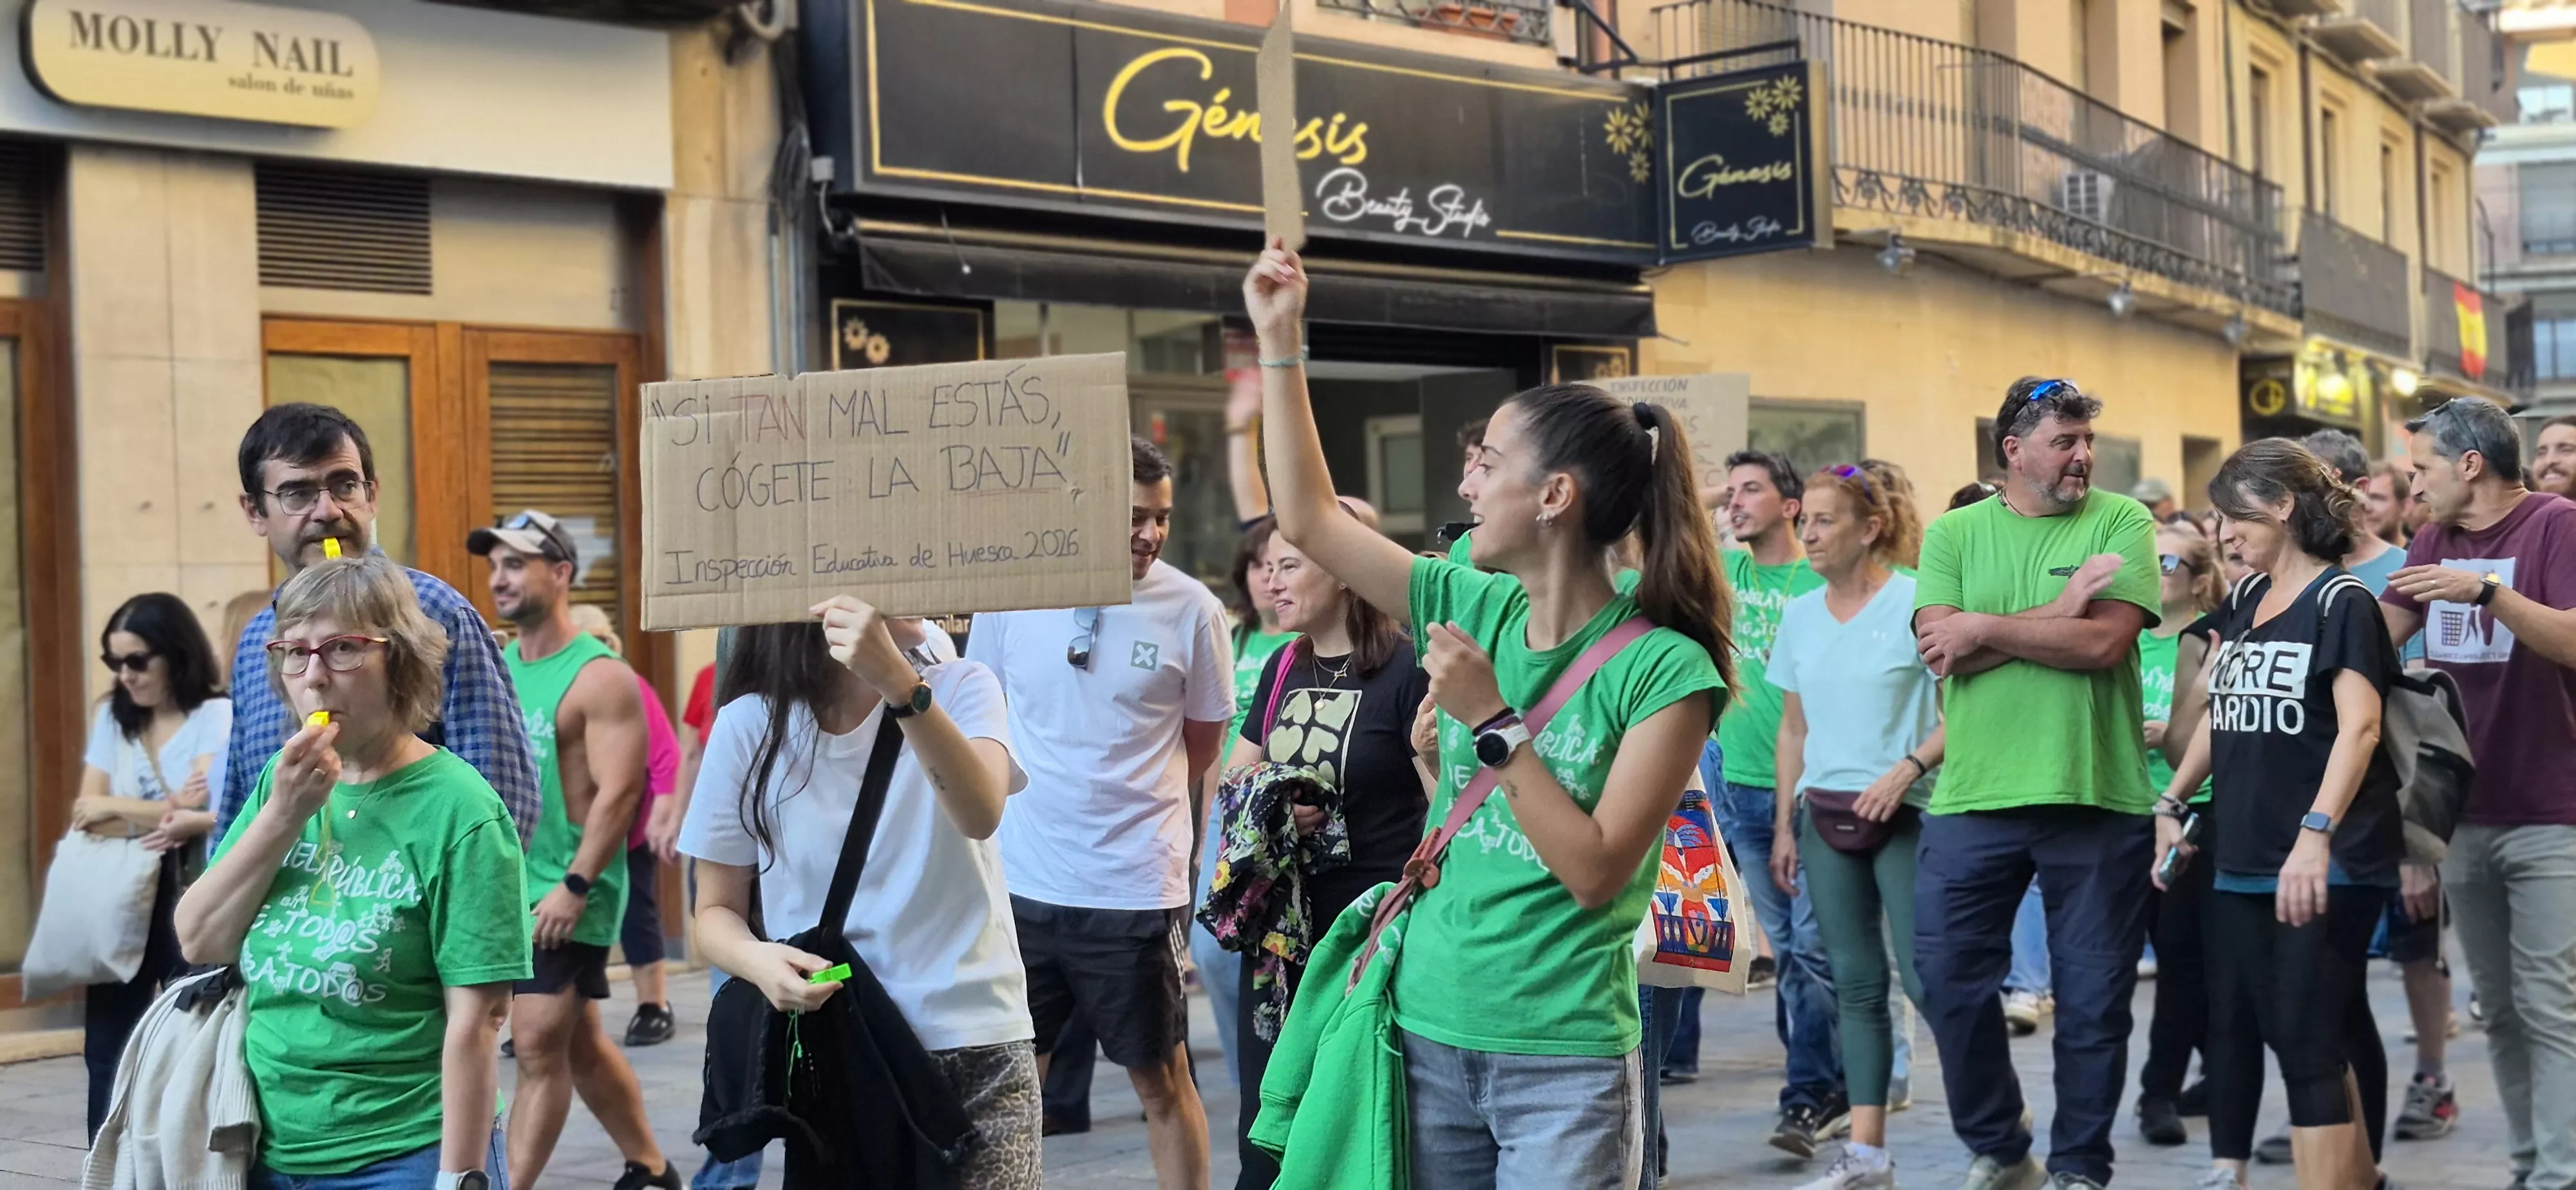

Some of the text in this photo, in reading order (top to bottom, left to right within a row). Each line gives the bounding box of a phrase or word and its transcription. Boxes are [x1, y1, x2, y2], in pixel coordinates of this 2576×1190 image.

[69, 10, 354, 77] MOLLY NAIL
[228, 74, 355, 99] salon de uñas
[1103, 47, 1368, 173] Génsis
[1316, 167, 1491, 238] Beauty Studio
[1678, 154, 1792, 199] Génesis
[730, 390, 806, 444] TAN
[828, 389, 909, 439] MAL
[930, 364, 1061, 429] ESTÁS,
[697, 451, 835, 511] CÓGETE
[869, 456, 920, 498] LA
[665, 528, 1079, 590] Inspección Educativa de Huesca 2026
[2209, 695, 2304, 735] ARDIO
[284, 907, 381, 954] TOD@S
[285, 963, 388, 1007] TOD@S
